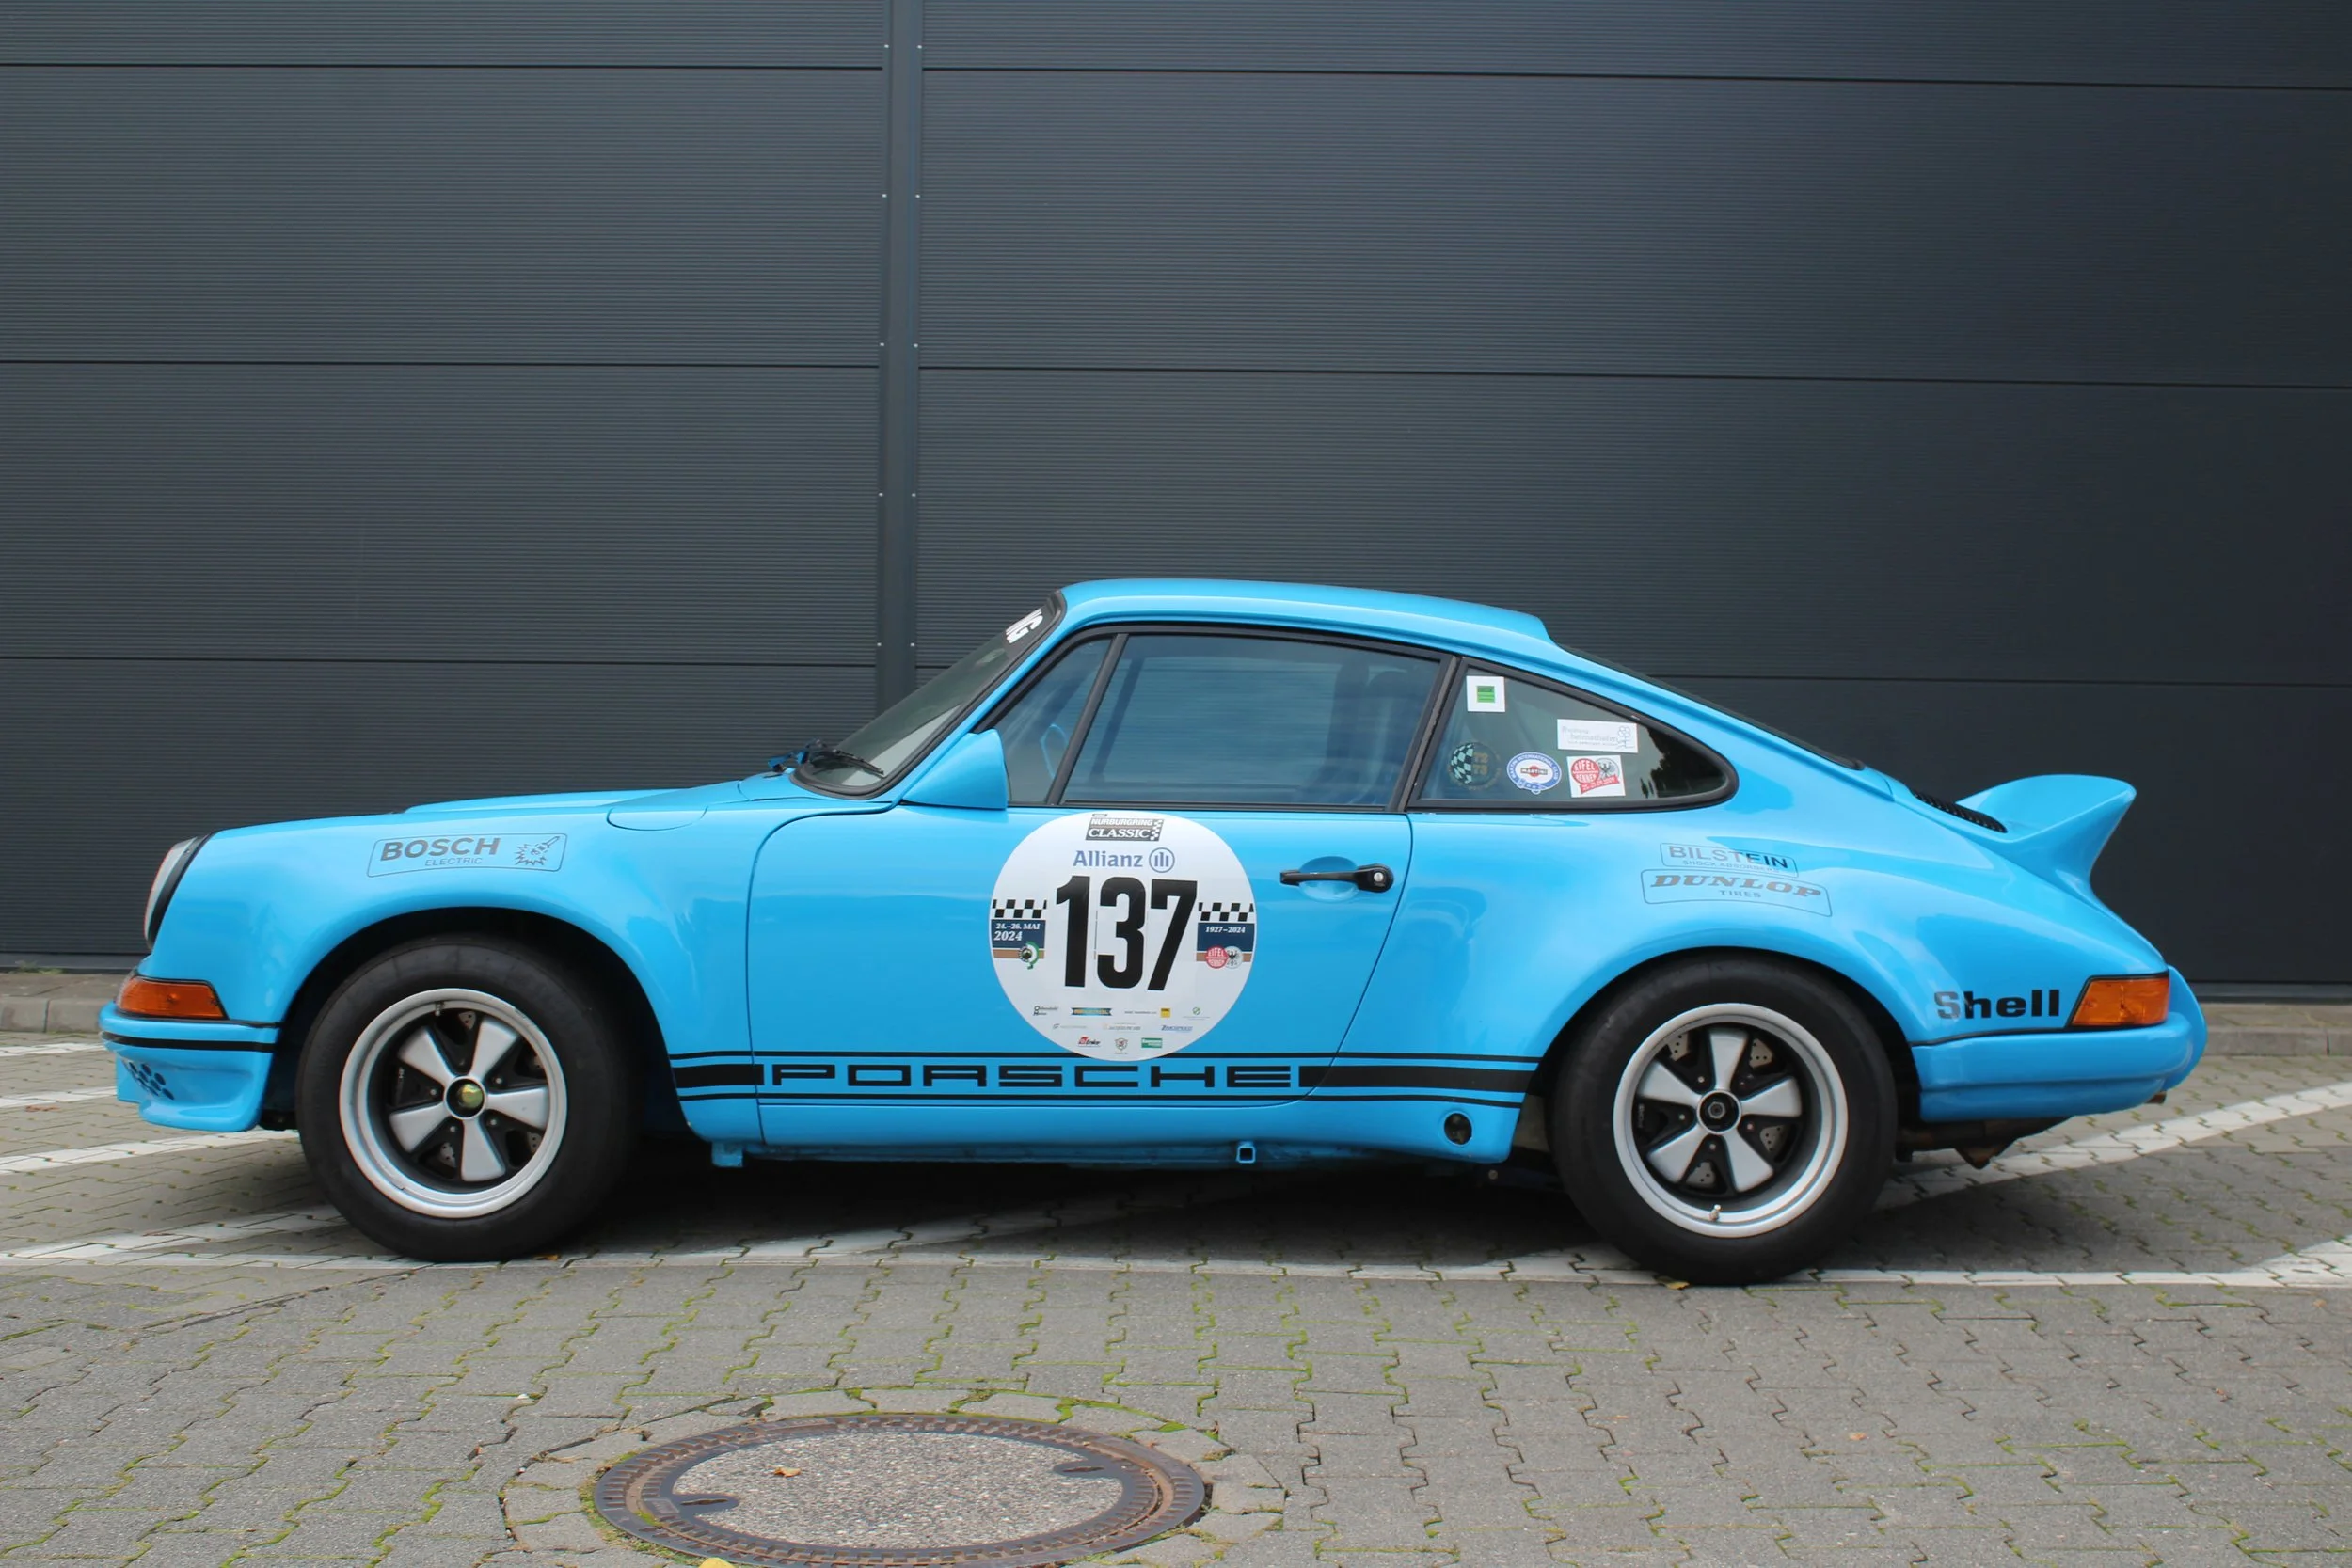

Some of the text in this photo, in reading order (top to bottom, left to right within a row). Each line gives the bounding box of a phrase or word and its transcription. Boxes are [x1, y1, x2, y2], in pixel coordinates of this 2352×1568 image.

[1574, 760, 1596, 771] EIFEL
[1089, 829, 1151, 838] CLASSIC
[380, 837, 501, 861] BOSCH
[1073, 850, 1144, 867] Allianz
[1669, 846, 1788, 868] BILSTEIN
[425, 857, 483, 866] ELECTRIC
[1650, 875, 1821, 896] DUNLOP
[1720, 890, 1762, 898] TIRES
[993, 930, 1023, 942] 2024
[1056, 875, 1198, 990] 137
[1934, 990, 2059, 1019] Shell
[771, 1064, 1291, 1087] PORSCHE
